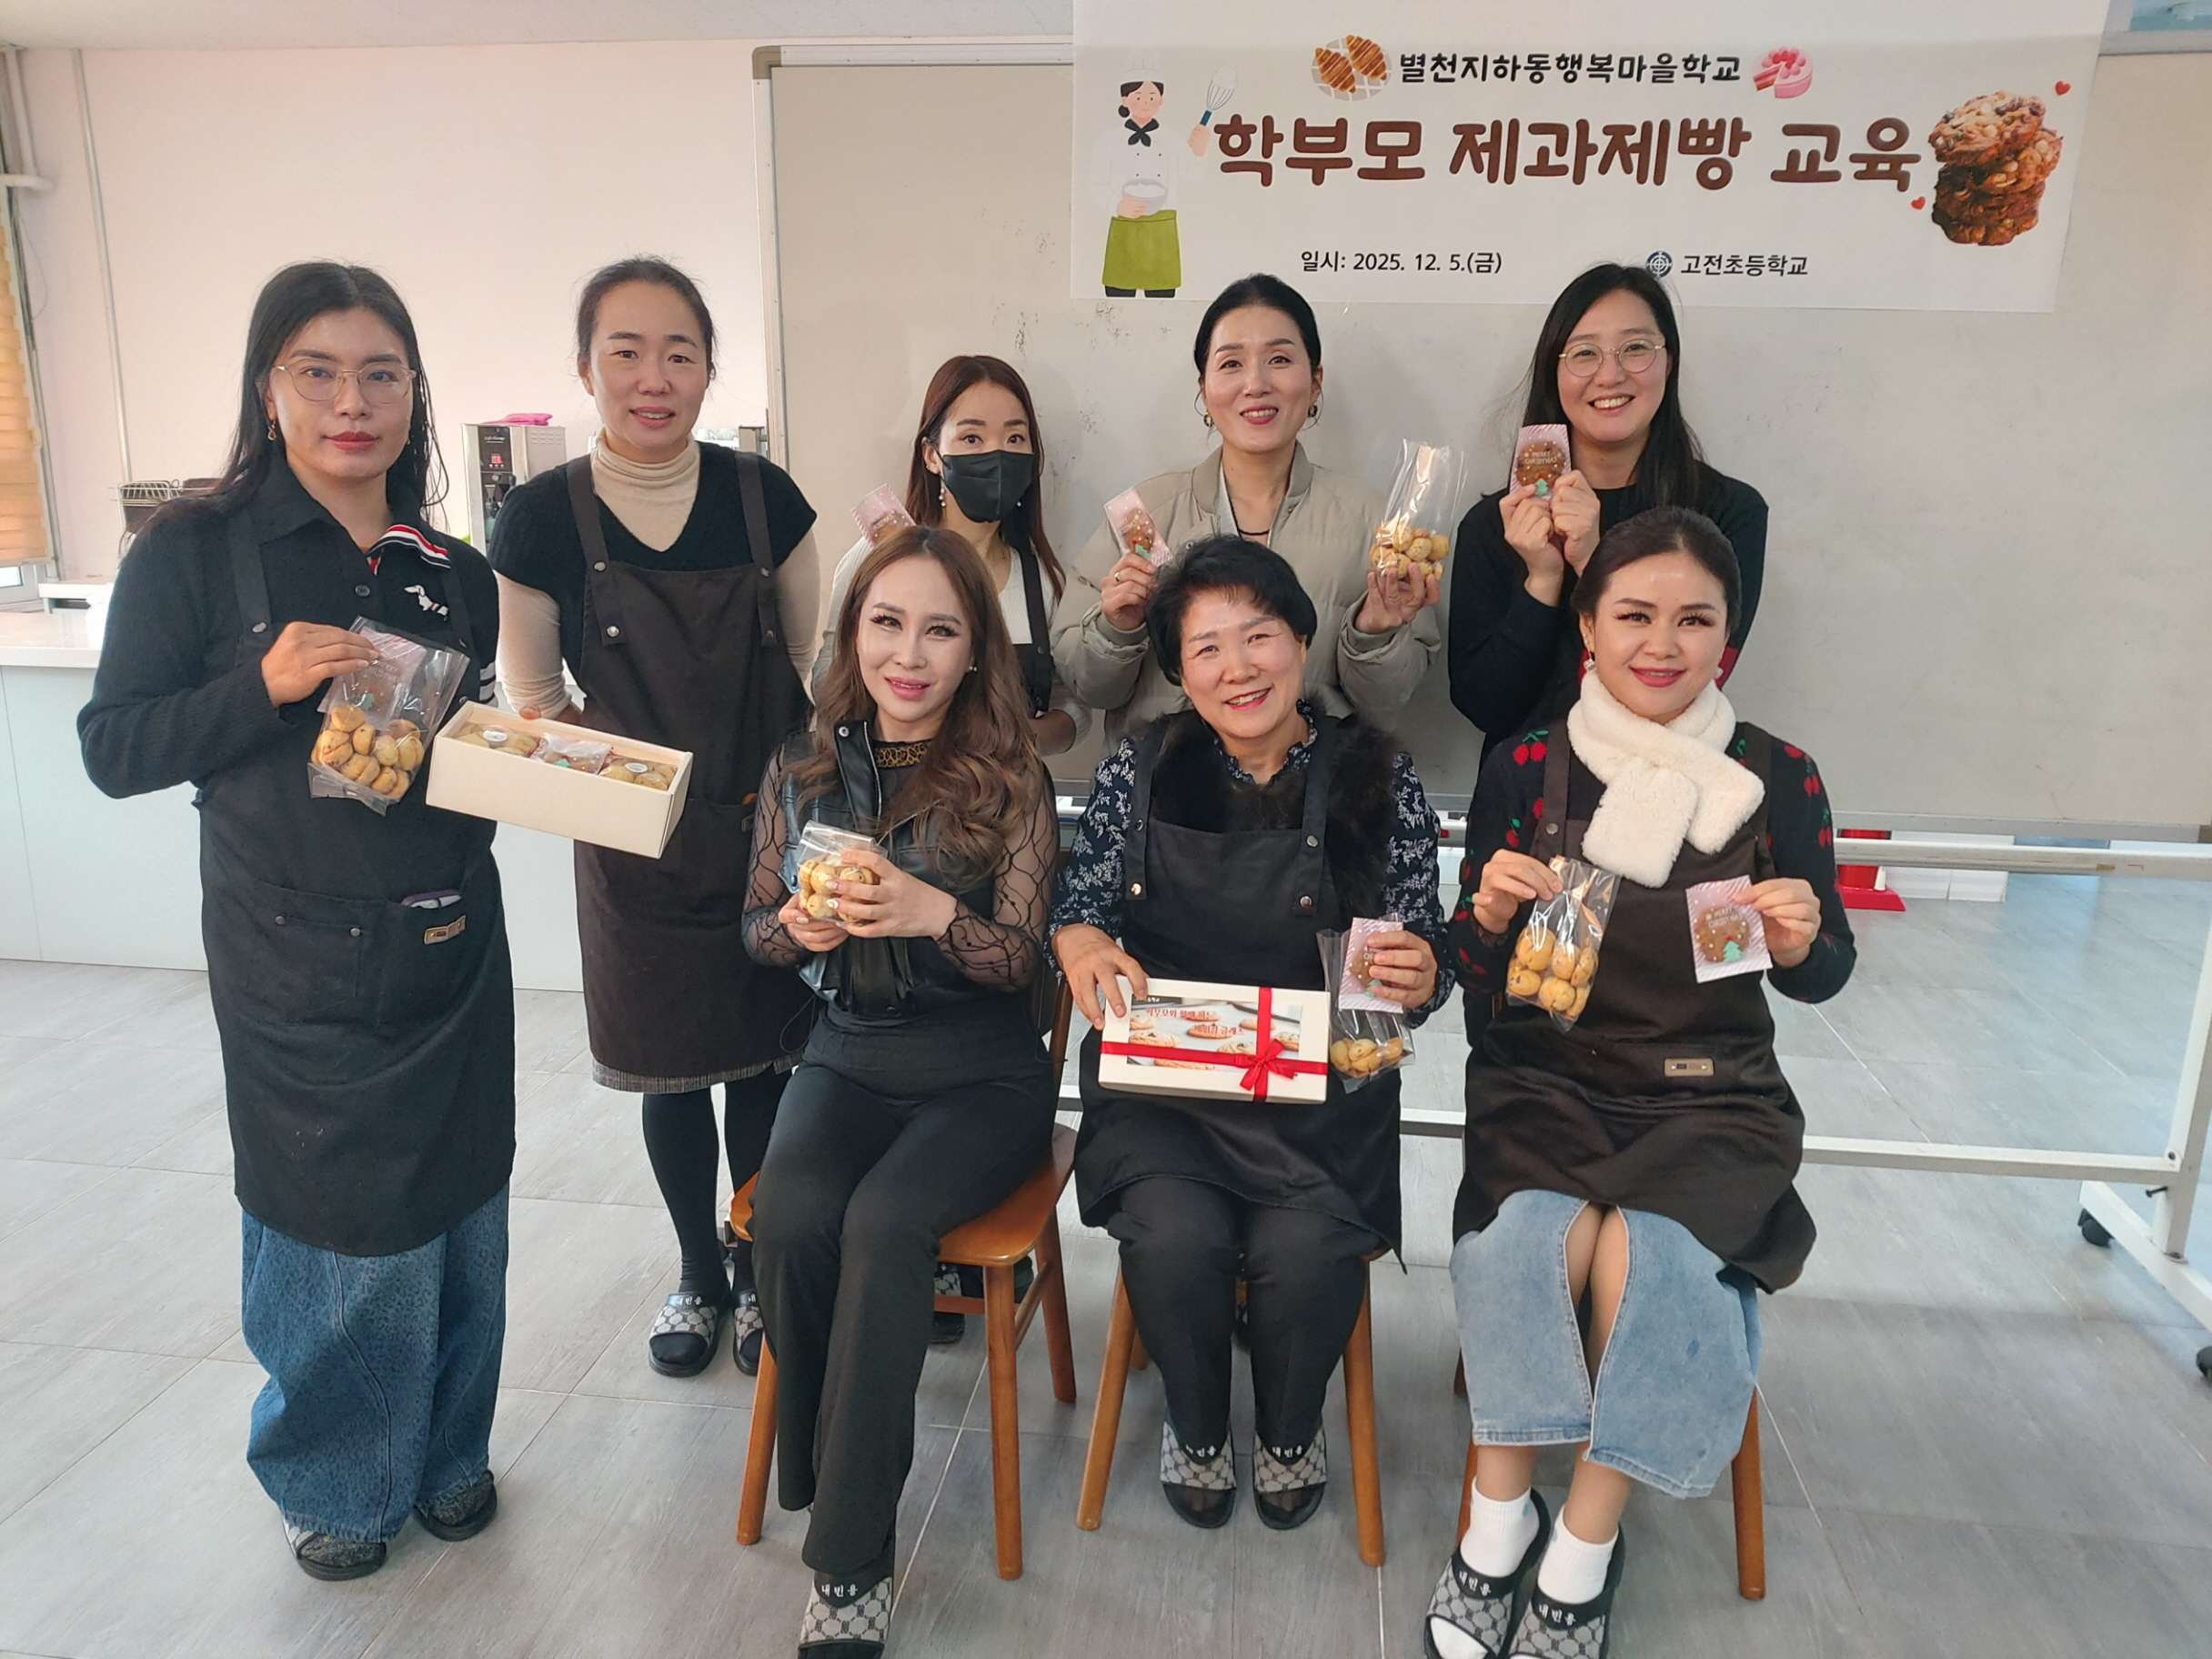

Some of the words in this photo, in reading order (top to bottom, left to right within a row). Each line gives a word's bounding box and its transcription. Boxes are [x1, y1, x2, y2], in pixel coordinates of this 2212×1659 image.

[1400, 52, 1741, 85] 별천지하동행복마을학교
[1213, 113, 1426, 187] 학부모
[1449, 116, 1753, 191] 제과제빵
[1770, 116, 1922, 193] 교육
[1301, 250, 1346, 272] 일시:
[1352, 253, 1405, 271] 2025.
[1414, 253, 1441, 271] 12.
[1449, 252, 1503, 274] 5.(금)
[1680, 254, 1809, 277] 고전초등학교
[820, 1583, 859, 1598] 내빈용
